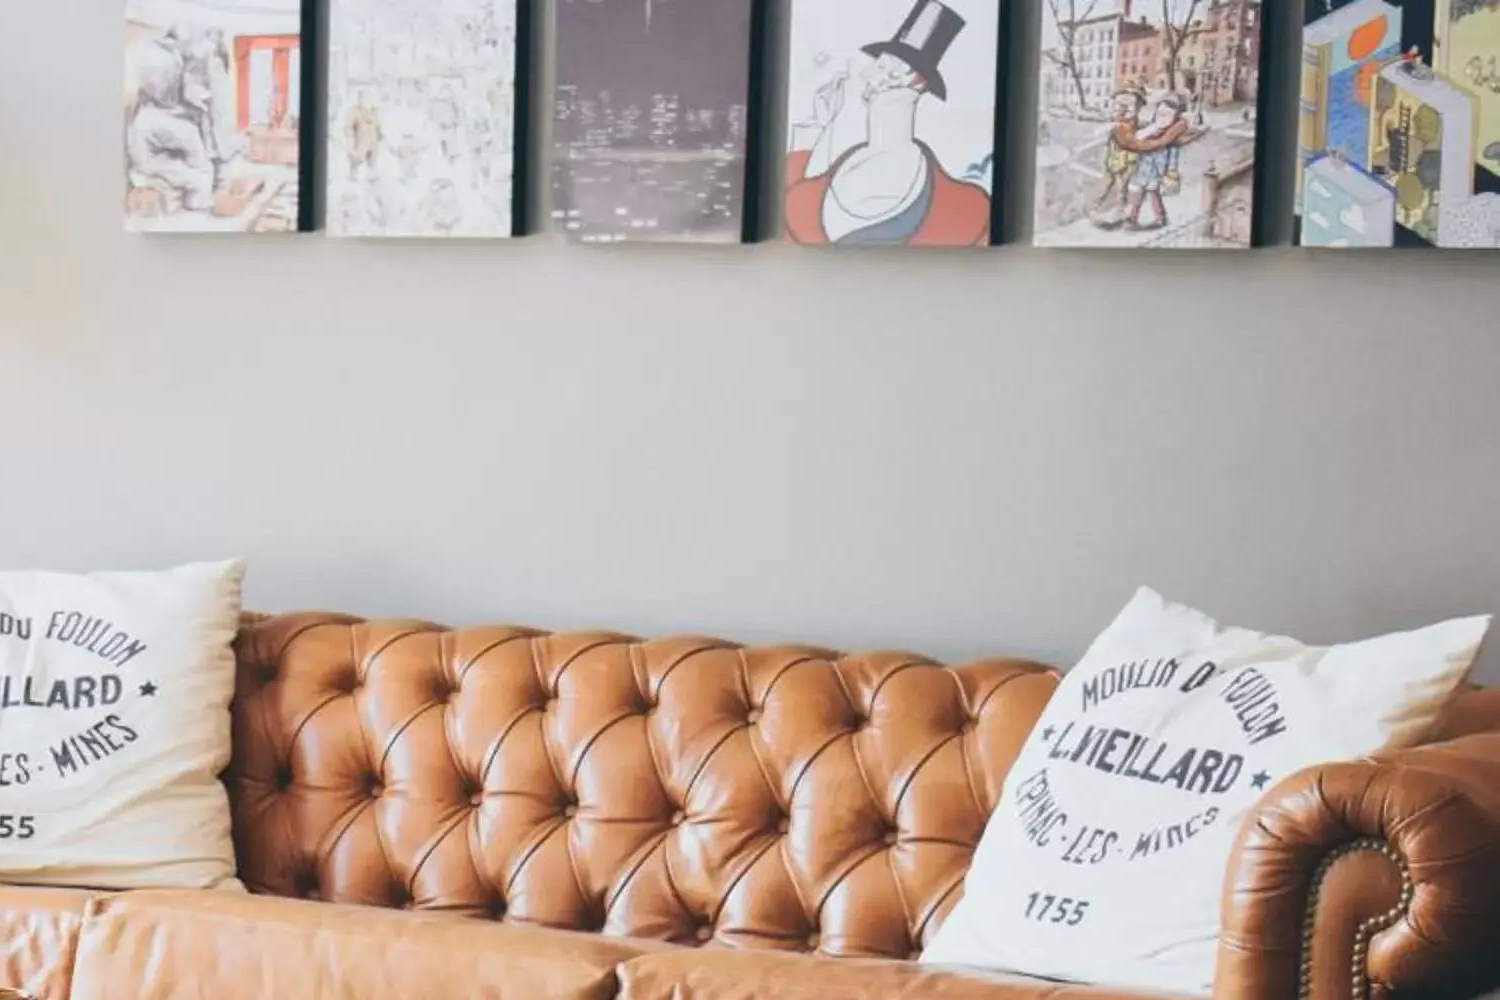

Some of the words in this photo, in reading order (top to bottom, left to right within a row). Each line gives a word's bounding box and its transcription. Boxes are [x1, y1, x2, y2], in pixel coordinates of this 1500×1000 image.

[45, 610, 148, 668] FOULON
[1081, 657, 1183, 712] MOULIN
[49, 713, 140, 779] MINES
[1023, 891, 1090, 927] 1755
